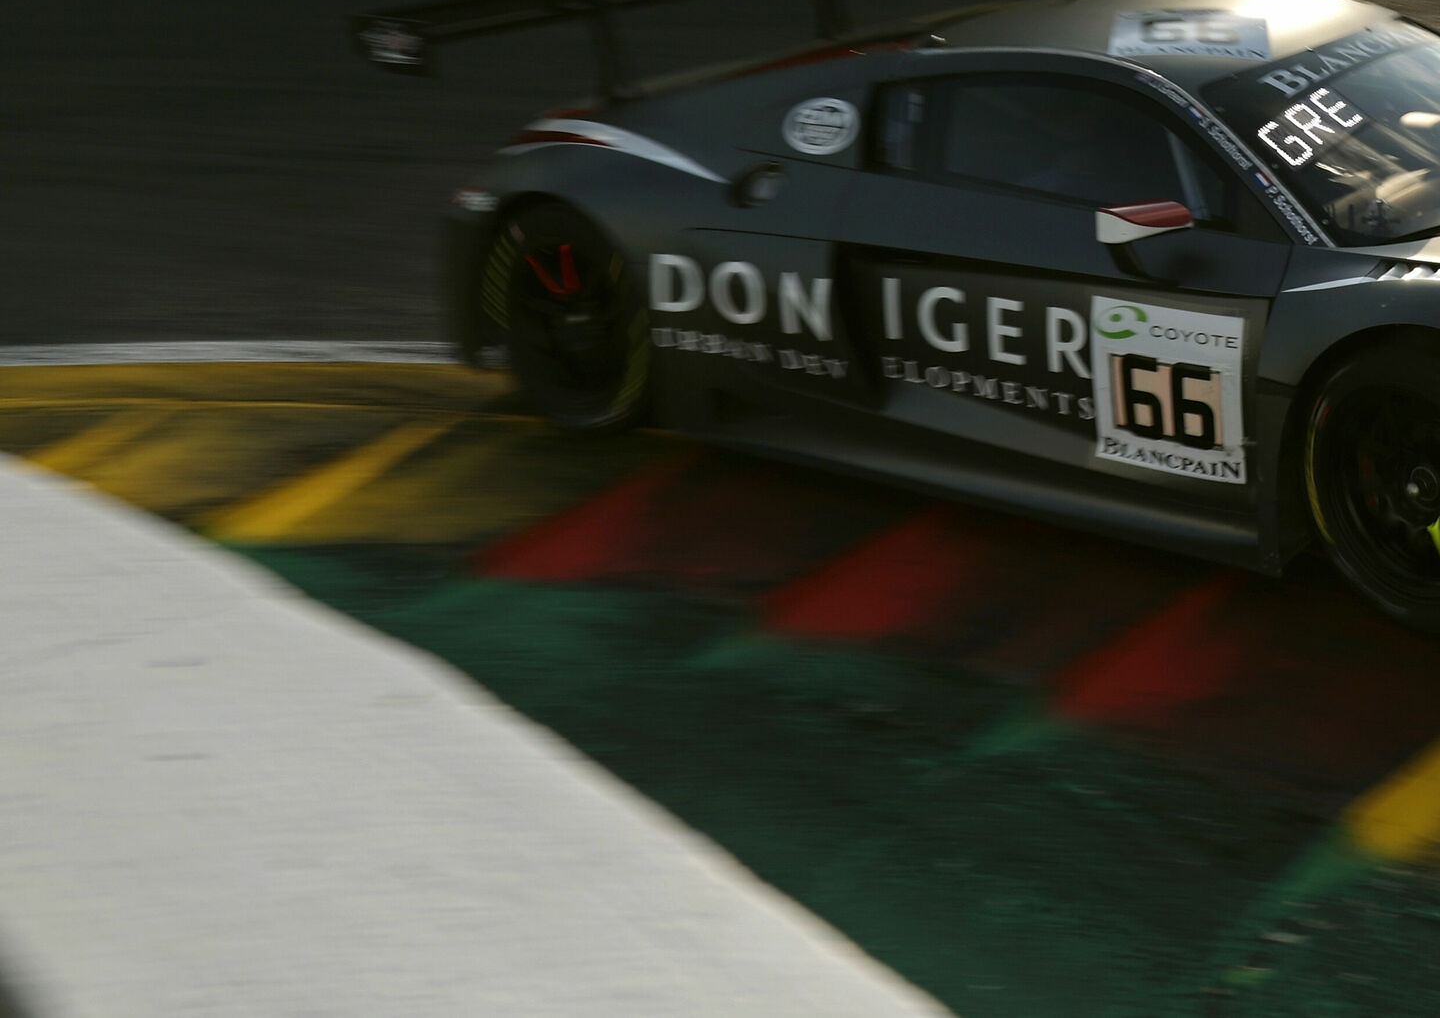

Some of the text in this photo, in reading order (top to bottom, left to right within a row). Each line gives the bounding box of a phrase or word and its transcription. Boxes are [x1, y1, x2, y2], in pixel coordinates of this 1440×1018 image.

[1256, 86, 1364, 167] GRE
[1150, 325, 1240, 350] COYOTE
[1121, 353, 1217, 450] 66
[1100, 436, 1242, 480] BLANCPAIN
